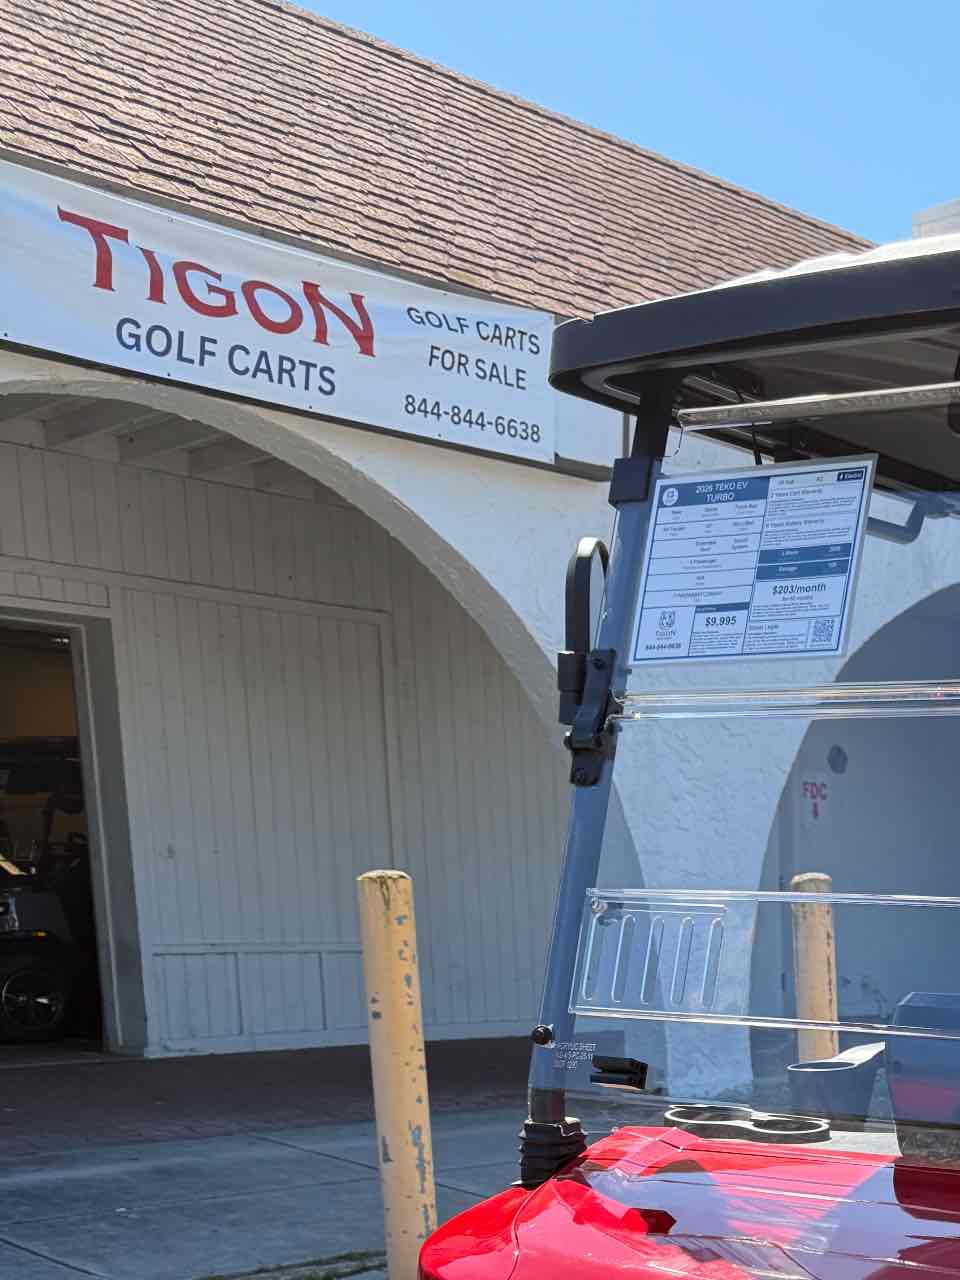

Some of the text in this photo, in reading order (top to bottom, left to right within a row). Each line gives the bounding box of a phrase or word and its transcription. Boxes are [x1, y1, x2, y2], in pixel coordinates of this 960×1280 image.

[57, 206, 376, 358] TIGON
[407, 306, 542, 355] GOLF CARTS
[115, 316, 336, 397] GOLF CARTS
[428, 345, 527, 391] FOR SALE
[403, 394, 542, 444] 844-844-6638
[706, 493, 735, 503] TURBO
[737, 481, 749, 490] EV
[772, 584, 827, 596] $203/month
[802, 781, 828, 800] FDC
